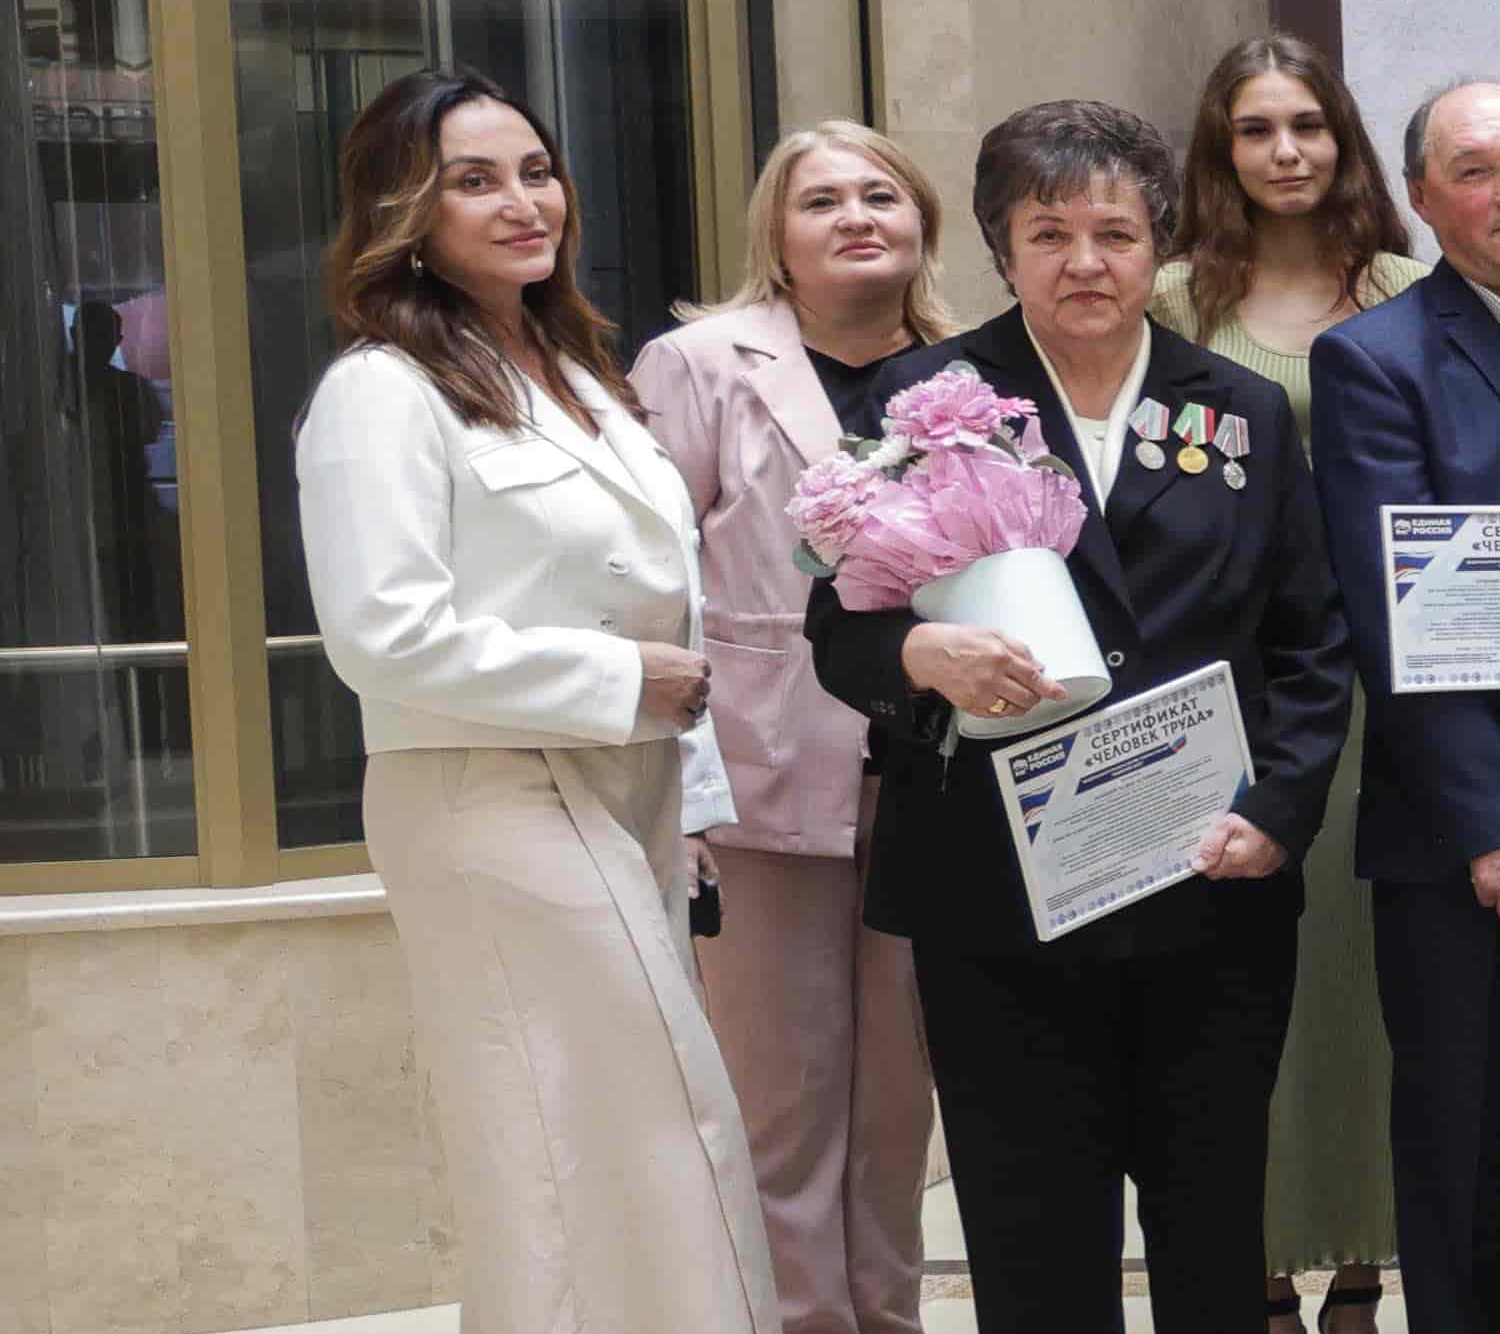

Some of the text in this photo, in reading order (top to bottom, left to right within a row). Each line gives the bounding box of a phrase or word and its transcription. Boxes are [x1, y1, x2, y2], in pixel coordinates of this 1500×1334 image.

[1084, 732, 1161, 768] «ЧЕЛОВЕК
[1160, 707, 1215, 737] ТРУДА»
[1091, 697, 1199, 750] СЕРТИФИКАТ
